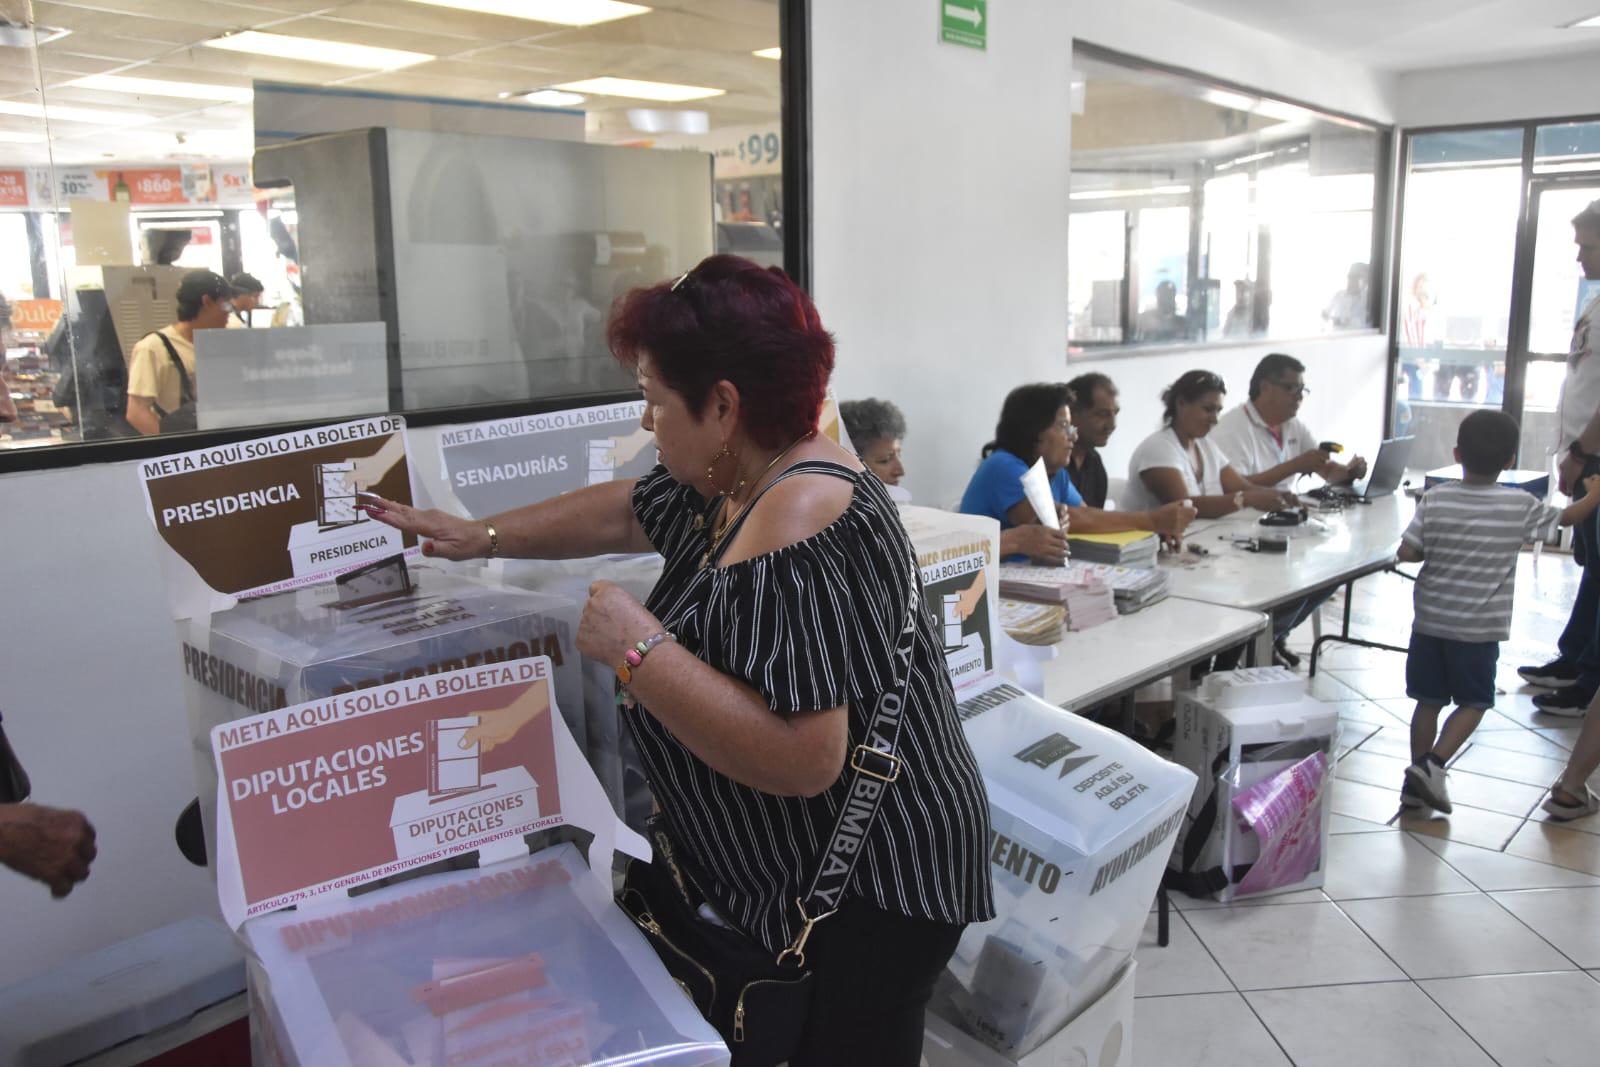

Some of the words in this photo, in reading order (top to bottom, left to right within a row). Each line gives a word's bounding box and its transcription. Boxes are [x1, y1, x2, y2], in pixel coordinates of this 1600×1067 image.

[738, 131, 779, 166] $99
[441, 428, 485, 446] META
[488, 419, 525, 437] AQUÍ
[524, 417, 566, 432] SOLO
[567, 413, 585, 426] LA
[587, 405, 636, 423] BOLETA
[143, 456, 195, 478] META
[200, 444, 242, 466] AQUÍ
[245, 438, 290, 459] SOLO
[293, 434, 315, 450] LA
[317, 422, 377, 445] BOLETA
[380, 418, 400, 433] DE
[455, 455, 569, 488] SENADURÍAS
[162, 483, 301, 527] PRESIDENCIA
[309, 535, 388, 564] PRESIDENCIA
[243, 585, 273, 599] GENERAL
[282, 572, 329, 590] INSTITUCIONES
[930, 570, 940, 582] LA
[942, 559, 972, 578] BOLETA
[973, 556, 984, 571] DE
[391, 612, 477, 636] BOLETA
[182, 640, 288, 714] PRESIDENCIA
[950, 658, 982, 678] TAMIENTO
[219, 718, 280, 749] META
[286, 698, 339, 731] AQUÍ
[343, 689, 400, 717] SOLO
[405, 682, 431, 703] LA
[436, 666, 514, 696] BOLETA
[519, 661, 546, 682] DE
[872, 690, 903, 754] OLA
[231, 731, 425, 801] DIPUTACIONES
[1073, 761, 1124, 793] DEPOSITE
[271, 765, 388, 815] LOCALES
[1094, 778, 1120, 800] AQUÍ
[1117, 772, 1135, 785] SU
[1108, 783, 1149, 811] BOLETA
[408, 794, 524, 838] DIPUTACIONES
[435, 814, 504, 845] LOCALES
[246, 896, 289, 916] ARTÍCULO
[289, 893, 308, 903] 279,
[318, 883, 336, 894] LEY
[334, 872, 371, 889] GENERAL
[371, 868, 383, 878] DE
[384, 851, 442, 874] INSTITUCIONES
[448, 830, 514, 855] PROCEDIMIENTOS
[514, 816, 564, 835] ELECTORALES
[991, 832, 1062, 895] ENTO
